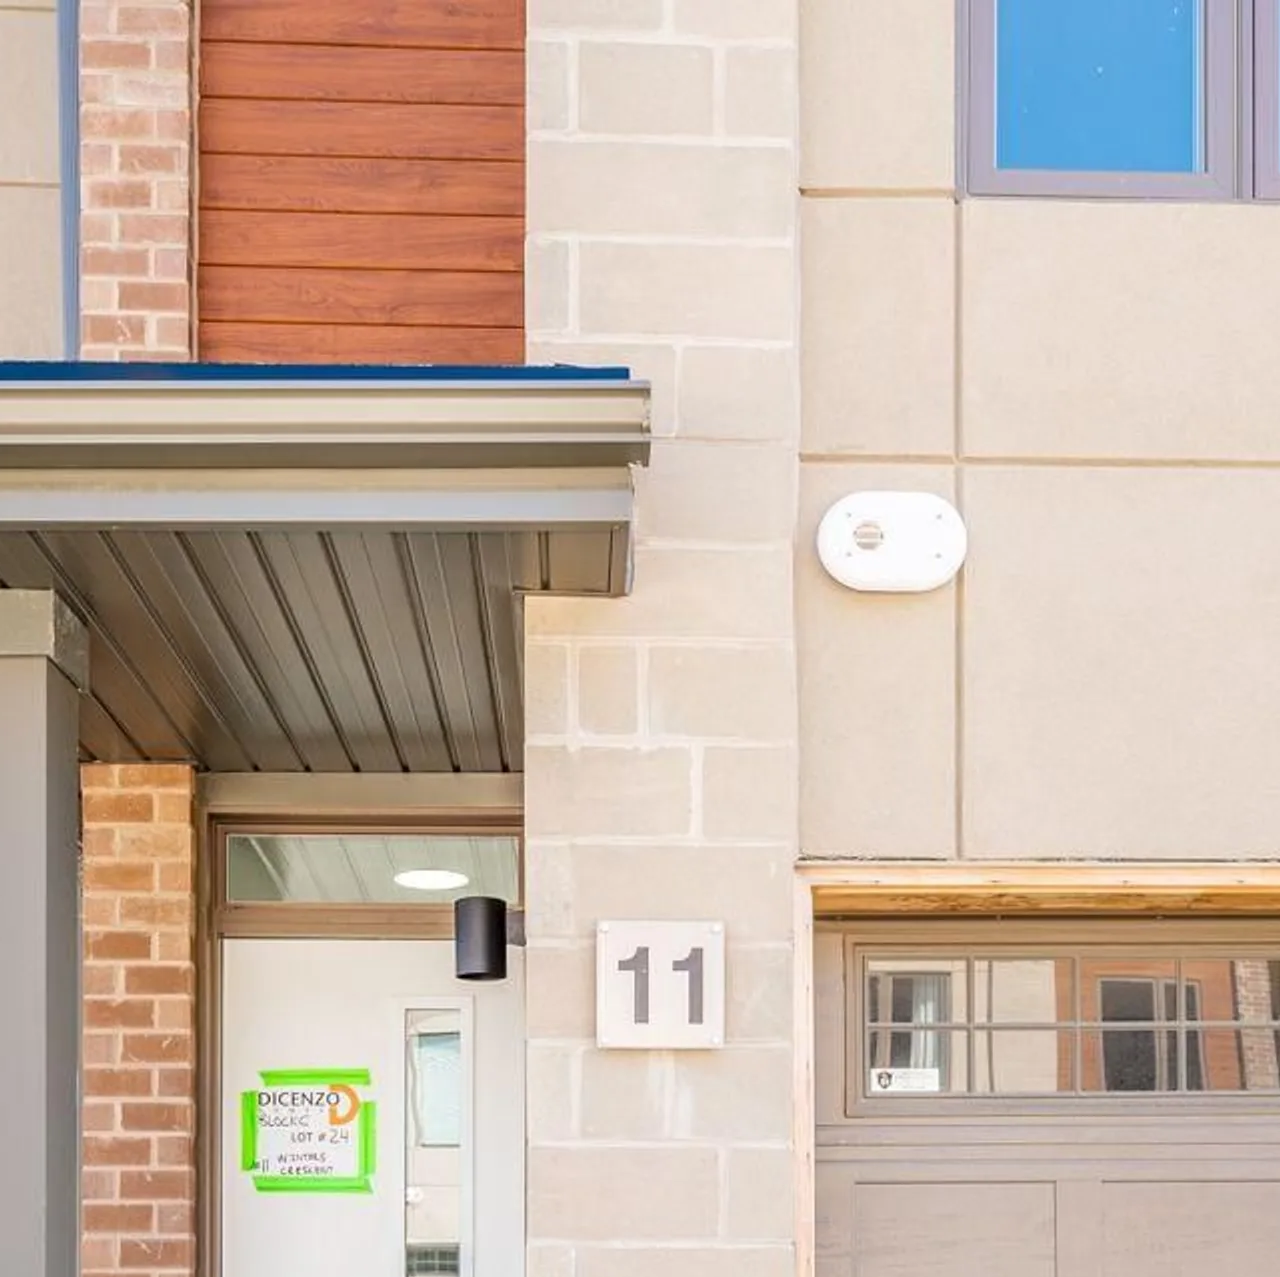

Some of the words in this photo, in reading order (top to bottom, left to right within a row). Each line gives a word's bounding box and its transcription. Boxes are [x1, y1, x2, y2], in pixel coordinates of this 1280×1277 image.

[617, 946, 703, 1025] 11
[258, 1091, 339, 1107] DICENZO
[291, 1131, 313, 1143] LOT
